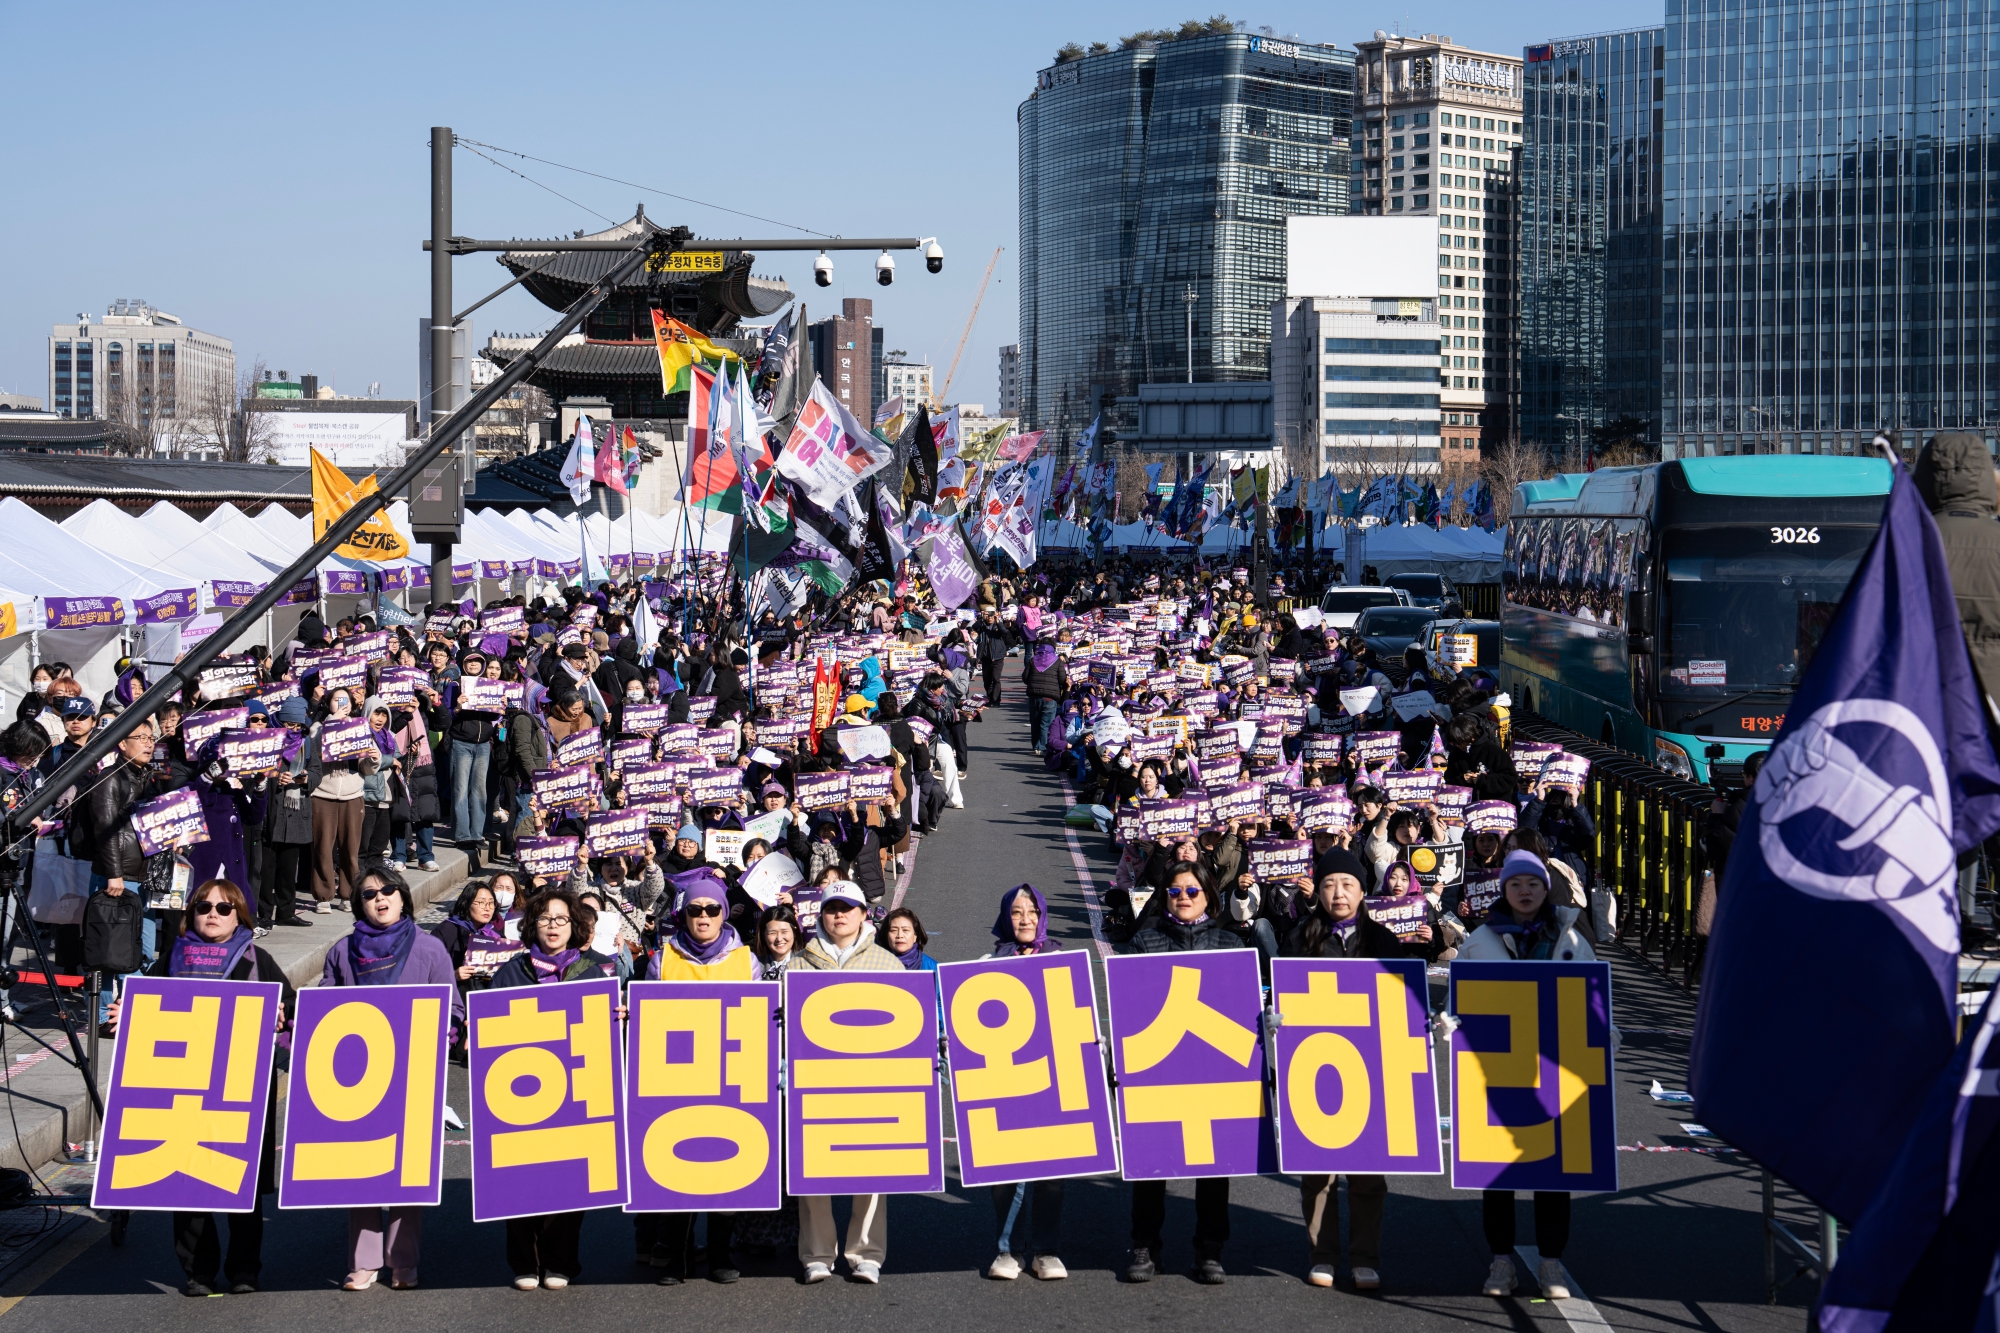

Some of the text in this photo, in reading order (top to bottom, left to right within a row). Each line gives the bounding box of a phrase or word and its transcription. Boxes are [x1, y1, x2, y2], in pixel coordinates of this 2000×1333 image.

[1261, 40, 1300, 59] 한국산업은행
[1444, 63, 1514, 90] SOMERSET
[695, 256, 721, 268] 단속중
[1771, 527, 1820, 543] 3026
[323, 661, 367, 679] 빛의혁명을
[326, 676, 362, 690] 완수하라!
[381, 679, 413, 693] 빛의혁명을
[69, 700, 83, 710] NY
[382, 692, 413, 705] 완수하라!
[626, 710, 667, 720] 빛의혁명을
[629, 719, 662, 730] 완수하라!
[756, 724, 795, 737] 빛의혁명을
[1741, 717, 1772, 732] 태양
[325, 725, 370, 745] 빛의혁명을
[661, 728, 698, 742] 빛의혁명을
[758, 735, 791, 746] 완수하라!
[1198, 732, 1238, 746] 빛의혁명을
[224, 742, 283, 757] 빛의혁명을
[329, 738, 373, 755] 완수하라!
[560, 733, 600, 757] 빛의혁명을
[613, 743, 650, 759] 빛의혁명을
[664, 738, 697, 749] 완수하라!
[1132, 739, 1174, 751] 빛의혁명을
[1201, 744, 1237, 757] 완수하라!
[1303, 739, 1340, 749] 빛의혁명을
[1357, 737, 1399, 751] 빛의혁명을
[559, 747, 598, 765] 완수하라!
[1136, 748, 1171, 759] 완수하라!
[1305, 750, 1335, 760] 완수하라!
[1361, 748, 1397, 760] 완수하라!
[228, 754, 278, 771] 완수하라!
[627, 769, 676, 784] 빛의혁명을
[1202, 762, 1241, 779] 빛의혁명을
[537, 774, 589, 791] 빛의혁명을
[629, 781, 673, 795] 완수하라!
[692, 775, 740, 792] 빛의혁명을
[798, 777, 847, 797] 빛의혁명을
[1386, 776, 1438, 790] 빛의혁명을
[541, 788, 586, 804] 완수하라!
[694, 789, 737, 801] 완수하라!
[802, 793, 845, 808] 완수하라!
[1211, 790, 1260, 809] 빛의혁명을
[1388, 789, 1433, 801] 완수하라!
[1144, 807, 1195, 822] 빛의혁명을
[1216, 803, 1259, 820] 완수하라!
[1303, 800, 1351, 818] 빛의혁명을
[1466, 805, 1516, 820] 빛의혁명을
[141, 802, 200, 832] 빛의혁명을
[1305, 815, 1346, 827] 완수하라!
[1471, 816, 1515, 831] 완수하라!
[149, 820, 202, 843] 완수하라!
[589, 817, 647, 838] 빛의혁명을
[1148, 821, 1192, 836] 완수하라!
[592, 832, 644, 851] 완수하라!
[521, 844, 575, 860] 빛의혁명을
[1252, 850, 1310, 863] 빛의혁명을
[525, 860, 571, 874] 완수하라!
[1257, 863, 1307, 876] 완수하라!
[184, 945, 228, 957] 빛의혁명을
[185, 956, 222, 967] 완수하라!
[950, 966, 1098, 1167] 완
[1122, 965, 1266, 1165] 수
[1278, 971, 1429, 1157] 하
[793, 982, 934, 1178] 을
[1455, 976, 1606, 1174] 라
[111, 993, 265, 1195] 빛
[292, 998, 441, 1187] 의
[477, 993, 619, 1194] 혁
[638, 996, 769, 1195] 명
